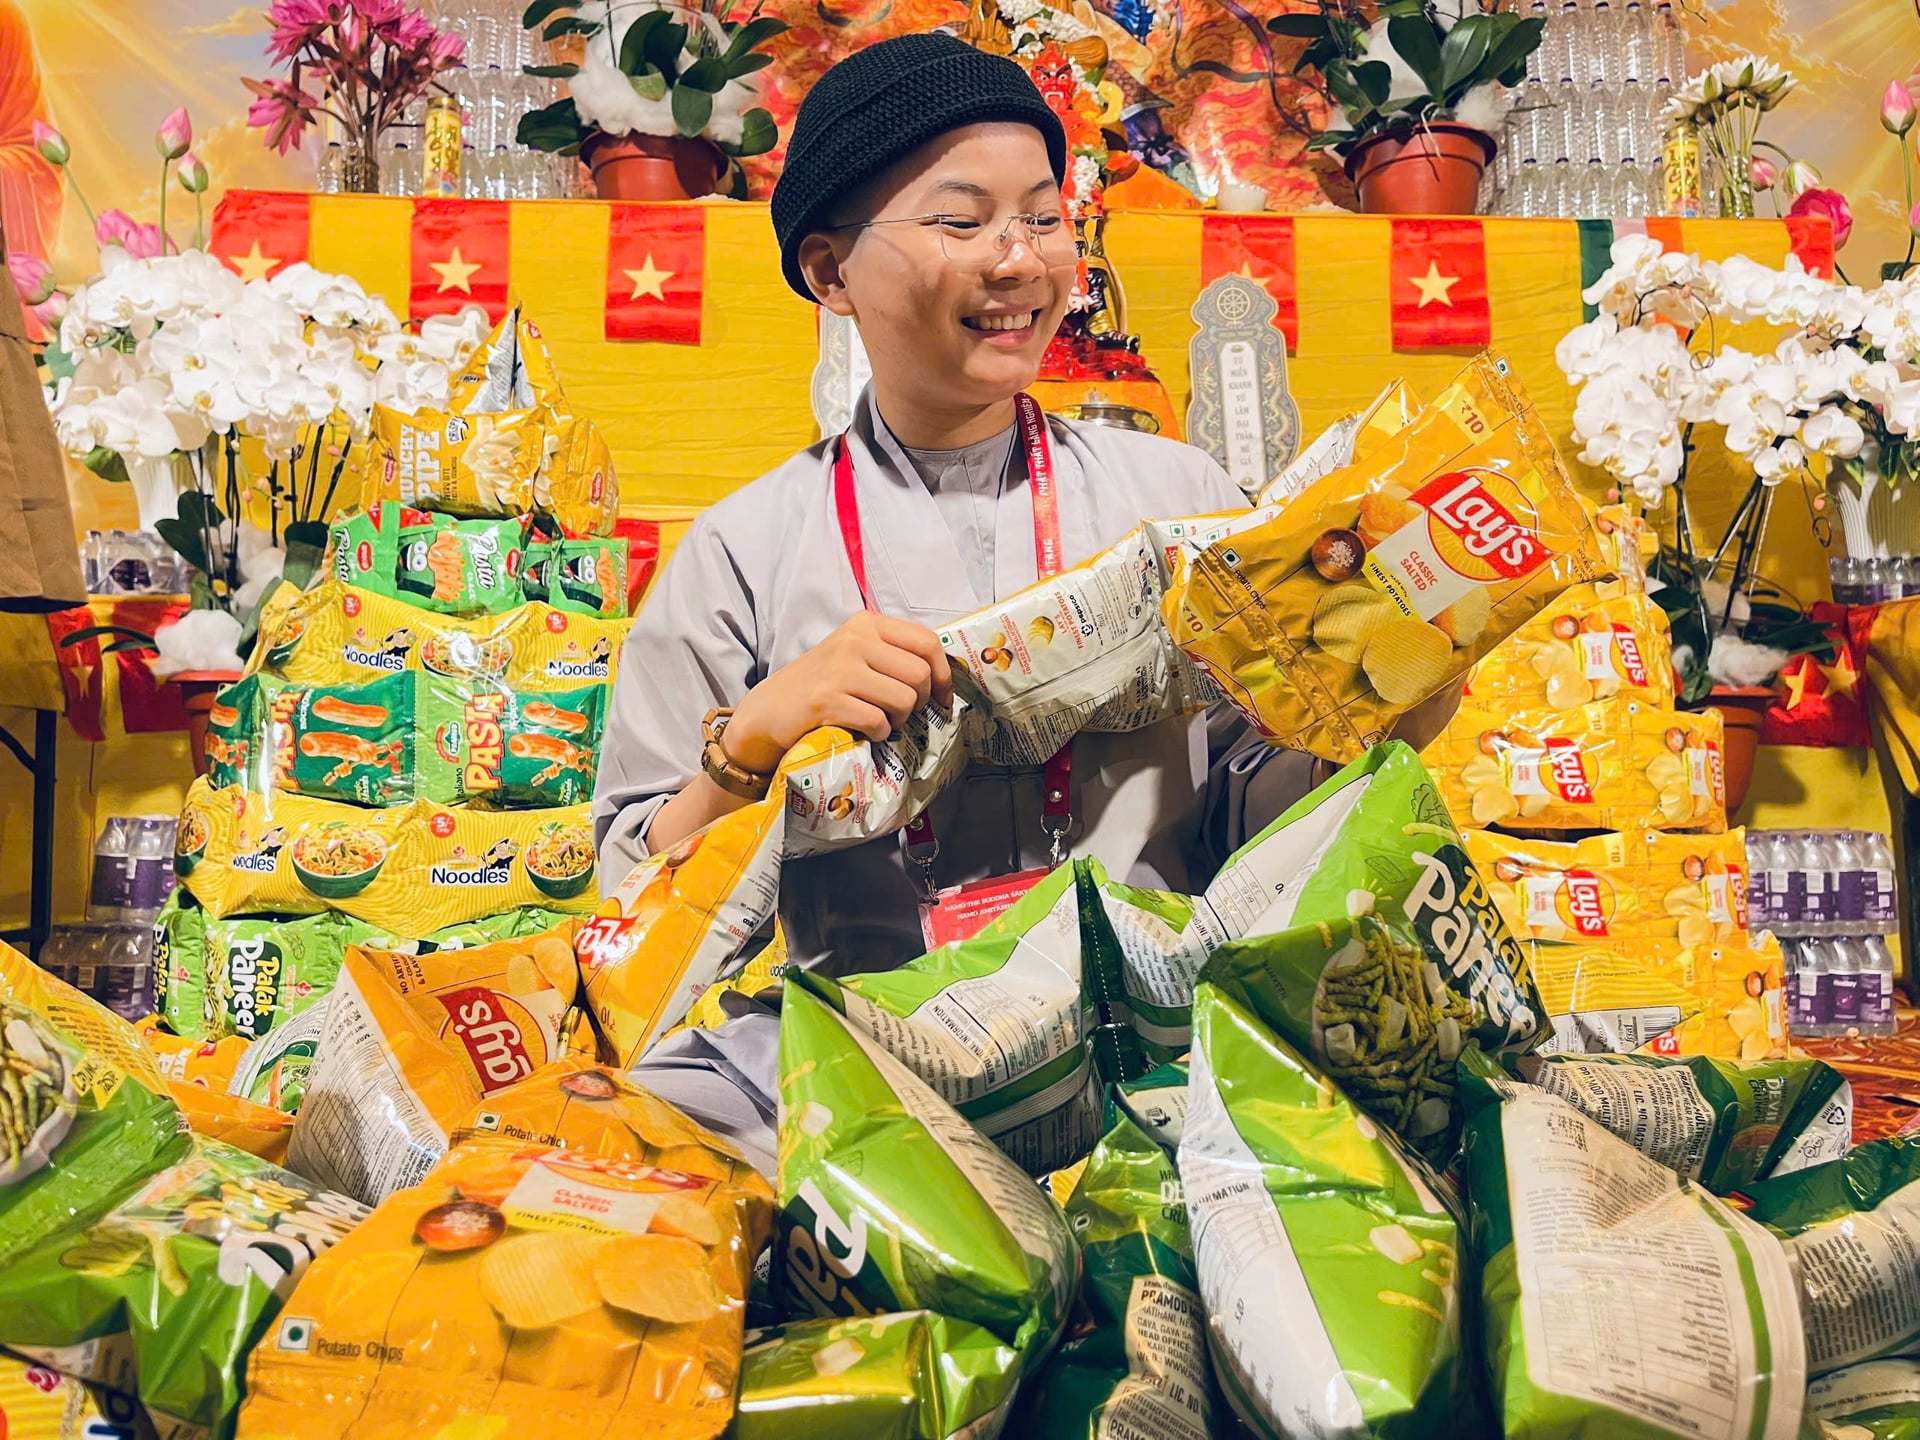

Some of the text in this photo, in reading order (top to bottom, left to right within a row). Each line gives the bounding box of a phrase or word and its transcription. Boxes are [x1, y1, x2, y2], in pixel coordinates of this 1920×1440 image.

[1462, 400, 1484, 434] ₹10
[416, 431, 440, 501] PIPE
[1429, 475, 1534, 566] Lay's
[335, 527, 350, 583] Pasta
[470, 532, 497, 590] Pasta
[1409, 551, 1439, 586] CLASSIC
[1234, 570, 1266, 610] Potato Chips
[1369, 563, 1412, 617] FINEST POTATOES
[1400, 558, 1427, 592] SALTED
[1054, 591, 1084, 650] FINEST POTATOES
[1054, 614, 1068, 634] LAY'S
[1069, 594, 1087, 624] pepsico
[343, 645, 405, 671] Noodles
[549, 660, 608, 679] Noodles
[1017, 653, 1032, 675] COOKED
[1616, 631, 1645, 682] Lay's
[271, 690, 304, 790] PASTA
[465, 694, 507, 791] PASTA
[456, 768, 464, 800] Italiano
[1550, 746, 1586, 798] Lay's
[1708, 749, 1724, 801] Lay's
[431, 868, 509, 884] Noodles
[944, 893, 1010, 912] NAMO THE BUDDHA
[1567, 876, 1603, 931] Lay's
[1729, 871, 1746, 923] Lay's
[957, 911, 979, 920] NAMO
[1459, 866, 1531, 1000] Palak
[158, 942, 169, 996] Palak
[232, 933, 264, 1036] Paneer
[254, 957, 280, 1017] Palak
[400, 981, 410, 994] NO
[934, 1005, 969, 1045] INFORMATION
[1580, 1066, 1604, 1095] PRAMOD
[1749, 1080, 1761, 1122] CRUNCH
[1821, 1102, 1835, 1120] OTHER
[504, 1125, 534, 1140] Potat
[1688, 1107, 1706, 1157] MULTIFOOD
[536, 1150, 690, 1184] Lay's
[552, 1196, 610, 1214] SALTED
[556, 1188, 616, 1206] CLASSIC
[516, 1211, 617, 1237] FINEST POTATOES
[1141, 1290, 1187, 1313] PRAMOD
[1138, 1329, 1160, 1342] HEAD
[1160, 1325, 1180, 1338] GAYA
[316, 1338, 404, 1364] Potato Chips
[1169, 1383, 1200, 1415] LIC. NO.
